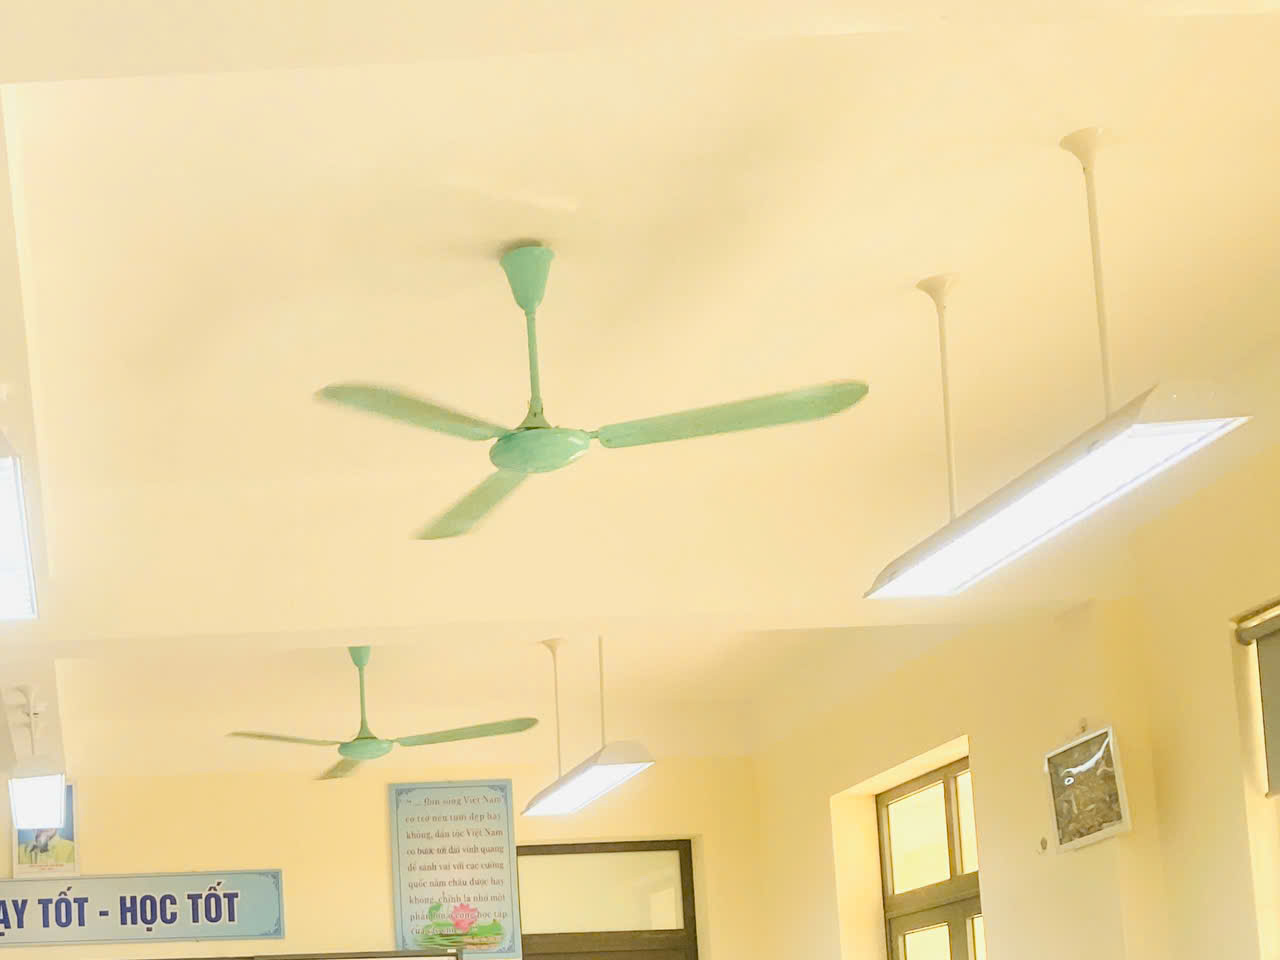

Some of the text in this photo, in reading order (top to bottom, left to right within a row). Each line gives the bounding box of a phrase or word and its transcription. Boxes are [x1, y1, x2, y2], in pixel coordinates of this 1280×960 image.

[38, 886, 89, 929] TỐT
[120, 894, 178, 933] HỌC
[187, 881, 239, 924] TỐT
